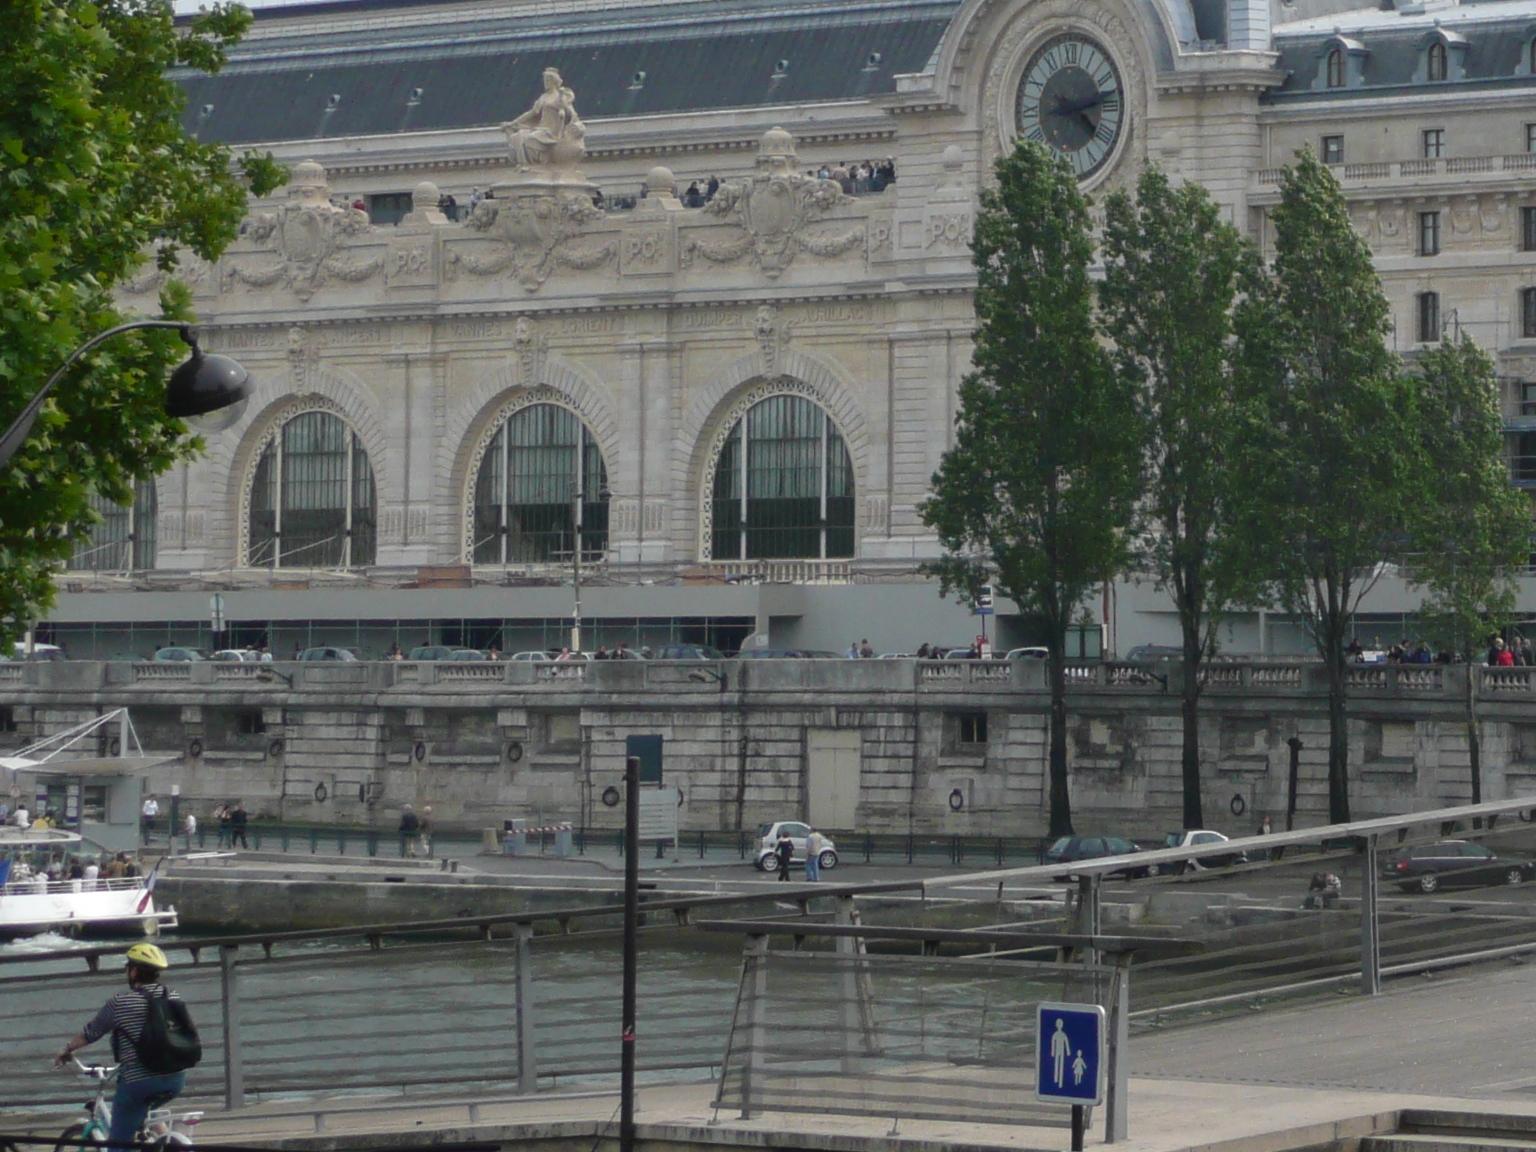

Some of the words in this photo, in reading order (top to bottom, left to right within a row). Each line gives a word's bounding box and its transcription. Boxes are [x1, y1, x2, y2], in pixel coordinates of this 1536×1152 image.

[1044, 51, 1058, 75] XI
[1065, 43, 1077, 64] XII
[1086, 50, 1095, 69] I
[1028, 75, 1044, 92] X
[1097, 71, 1113, 87] II
